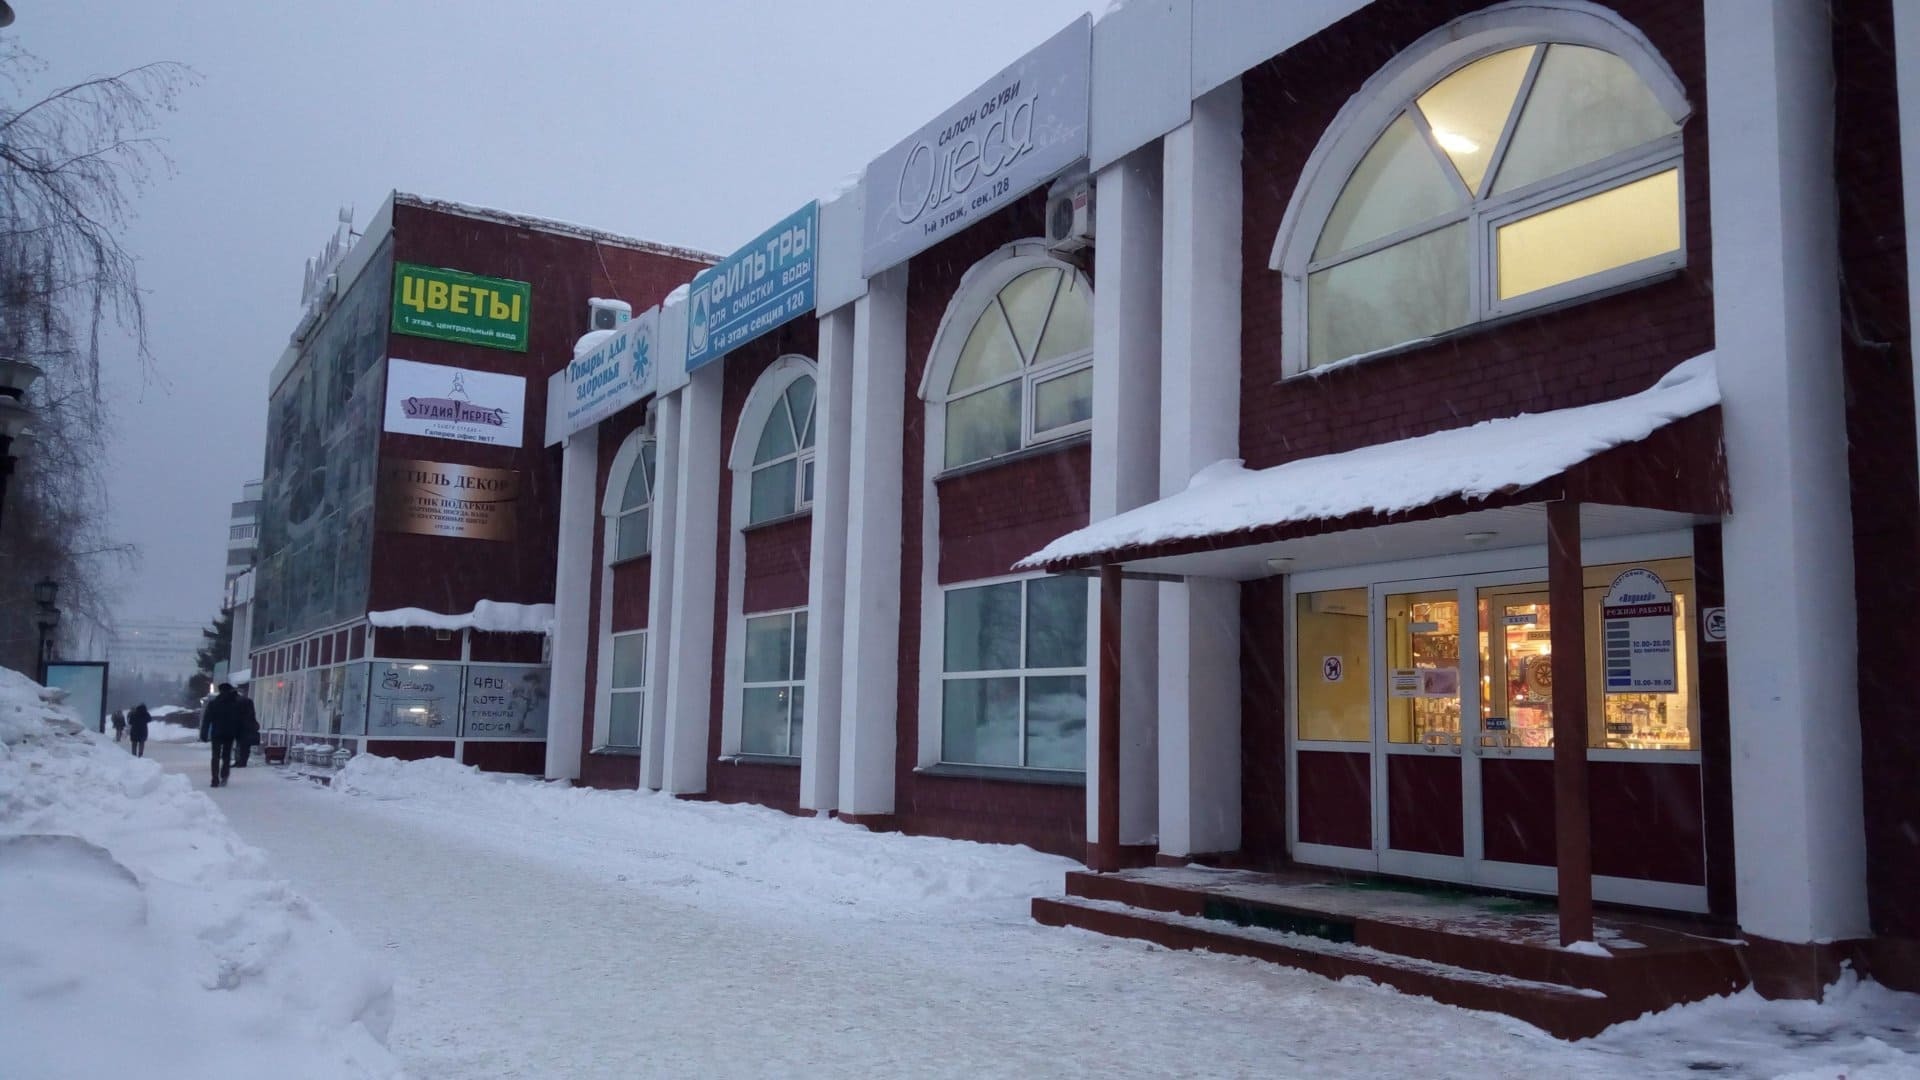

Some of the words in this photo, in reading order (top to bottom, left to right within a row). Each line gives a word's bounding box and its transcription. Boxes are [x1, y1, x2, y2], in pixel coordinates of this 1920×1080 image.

[939, 109, 977, 147] САЛОН
[980, 79, 1021, 120] ОБУВИ
[940, 206, 968, 229] этаж,
[711, 216, 811, 304] ФИЛЬТРЫ
[402, 276, 521, 322] ЦВЕТЫ
[710, 308, 727, 329] ДЛЯ
[732, 279, 774, 315] ОЧИСТКИ
[782, 257, 811, 286] ВОДЫ
[436, 322, 494, 337] центральный
[495, 331, 517, 341] вход
[713, 333, 726, 351] 1-й
[727, 327, 749, 344] этаж
[750, 304, 784, 331] секция
[786, 290, 804, 313] 120
[570, 348, 605, 383] Товары
[608, 333, 627, 362] для
[576, 361, 620, 401] здоровья
[393, 467, 450, 487] ТИЛЬ
